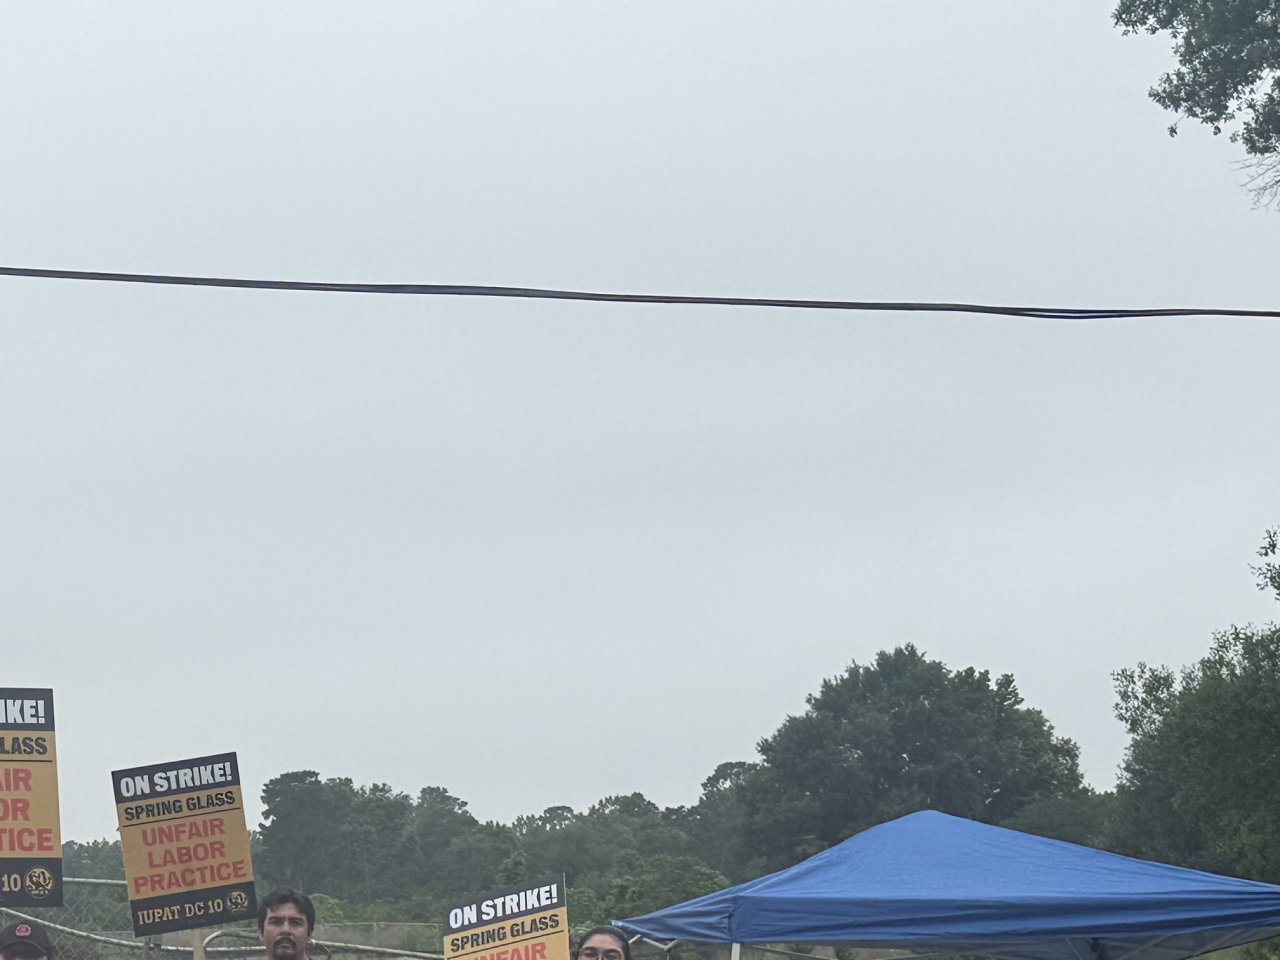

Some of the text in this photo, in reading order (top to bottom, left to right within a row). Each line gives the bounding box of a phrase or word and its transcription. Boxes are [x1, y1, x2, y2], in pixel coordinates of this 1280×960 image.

[120, 762, 233, 797] ON STRIKE!
[124, 791, 236, 821] SPRING GLASS
[141, 818, 225, 846] UNFAIR
[147, 841, 225, 869] LABOR
[2, 874, 21, 892] 10
[133, 859, 247, 895] PRACTICE
[138, 899, 223, 925] IUPAT DC 10
[449, 884, 558, 929] ON STRIKE!
[451, 914, 559, 953] SPRING GLASS
